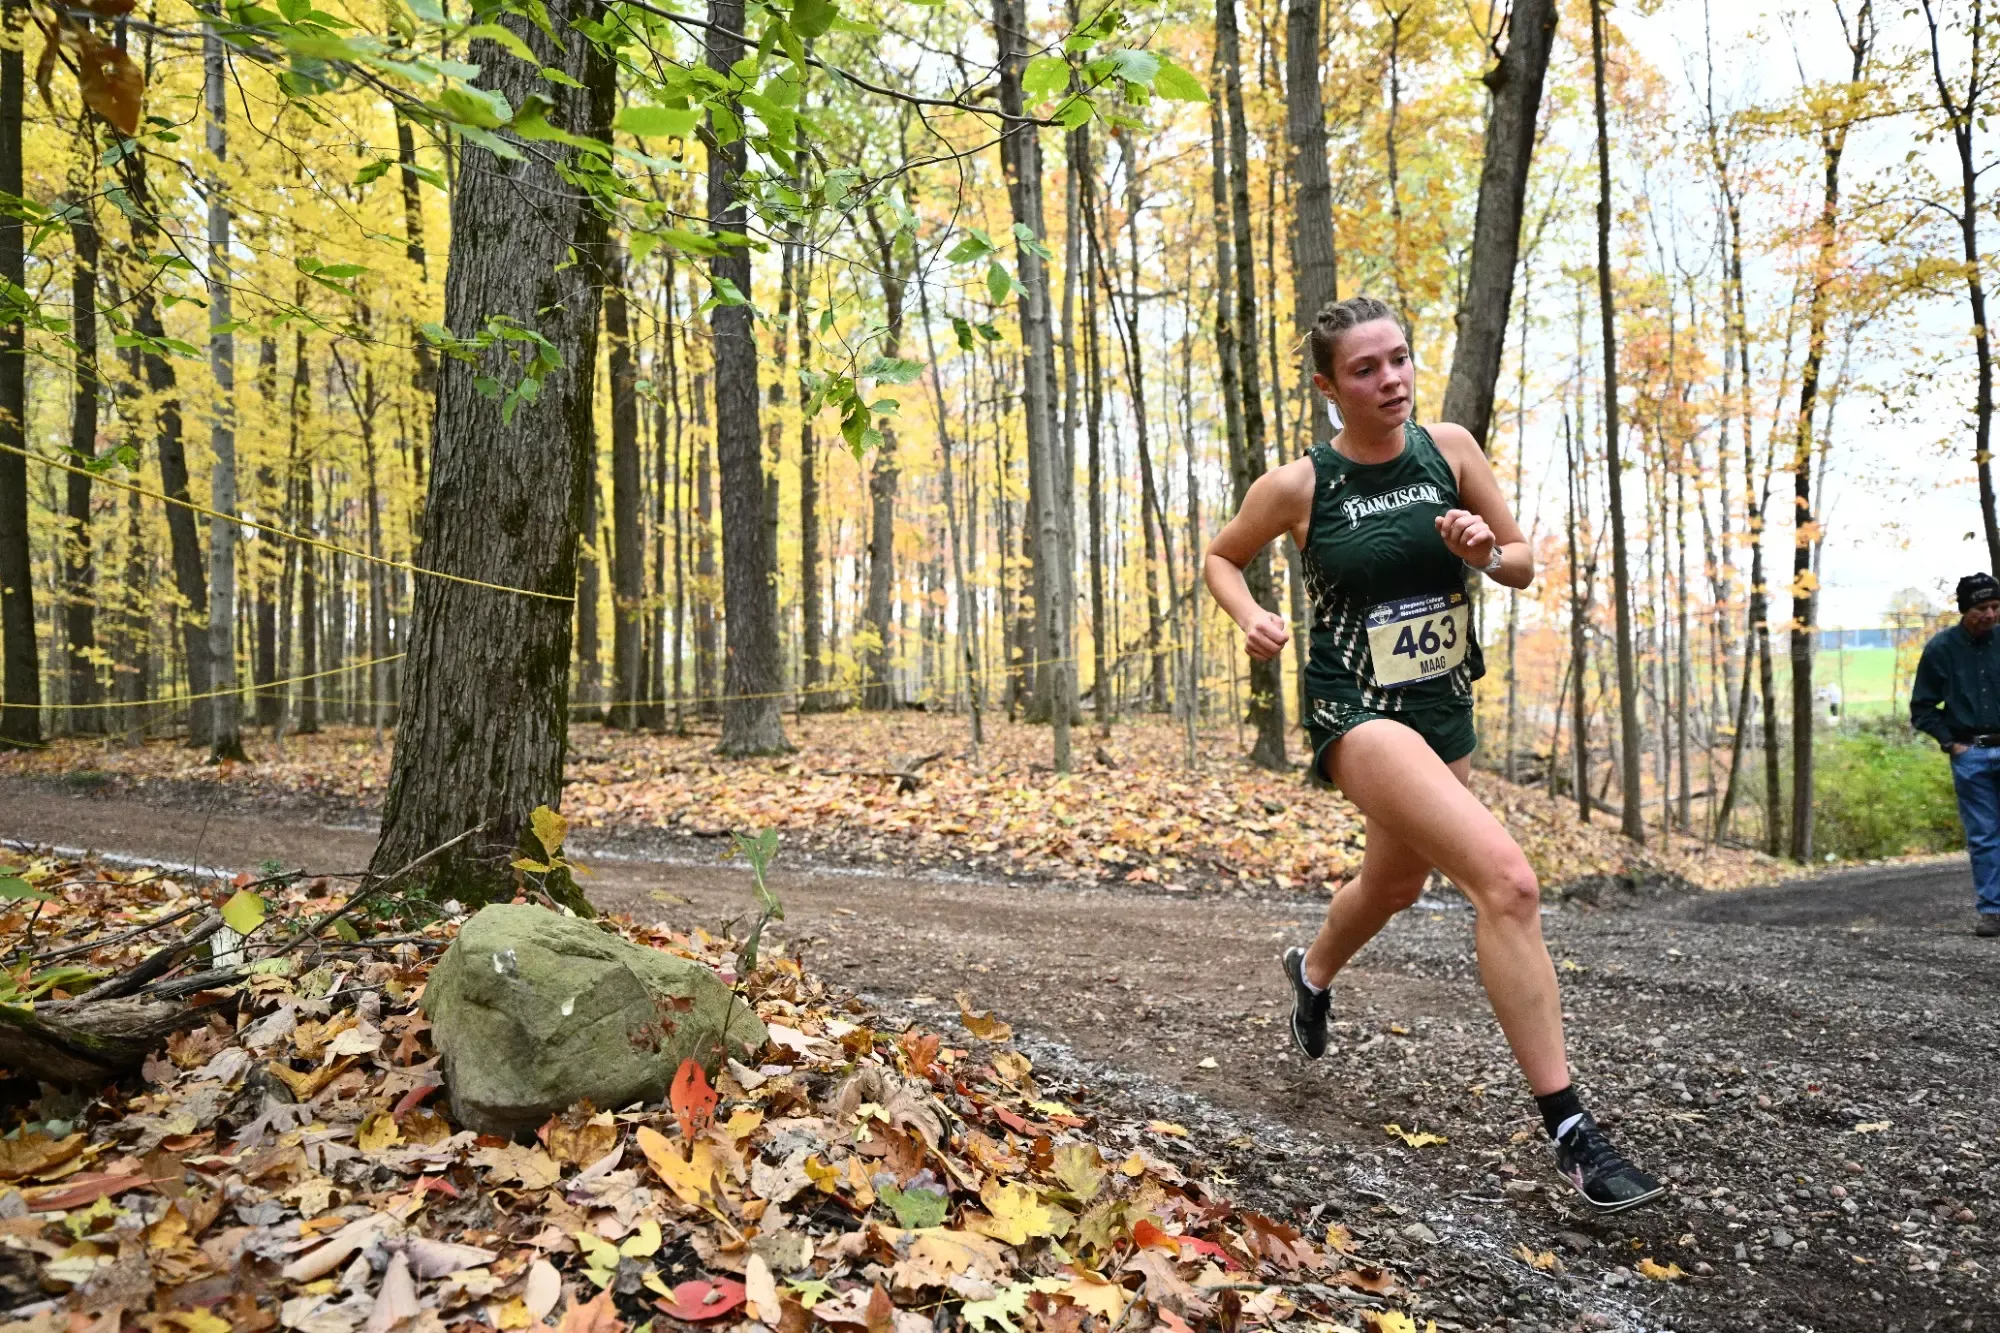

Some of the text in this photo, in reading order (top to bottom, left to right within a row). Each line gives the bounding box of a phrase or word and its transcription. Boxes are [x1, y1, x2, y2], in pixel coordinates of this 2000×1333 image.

[1342, 484, 1440, 528] FRANCISCAN
[1400, 601, 1425, 610] Allegheny
[1425, 596, 1443, 604] College
[1400, 606, 1427, 616] November
[1392, 615, 1456, 659] 463
[1420, 656, 1446, 674] MAAG
